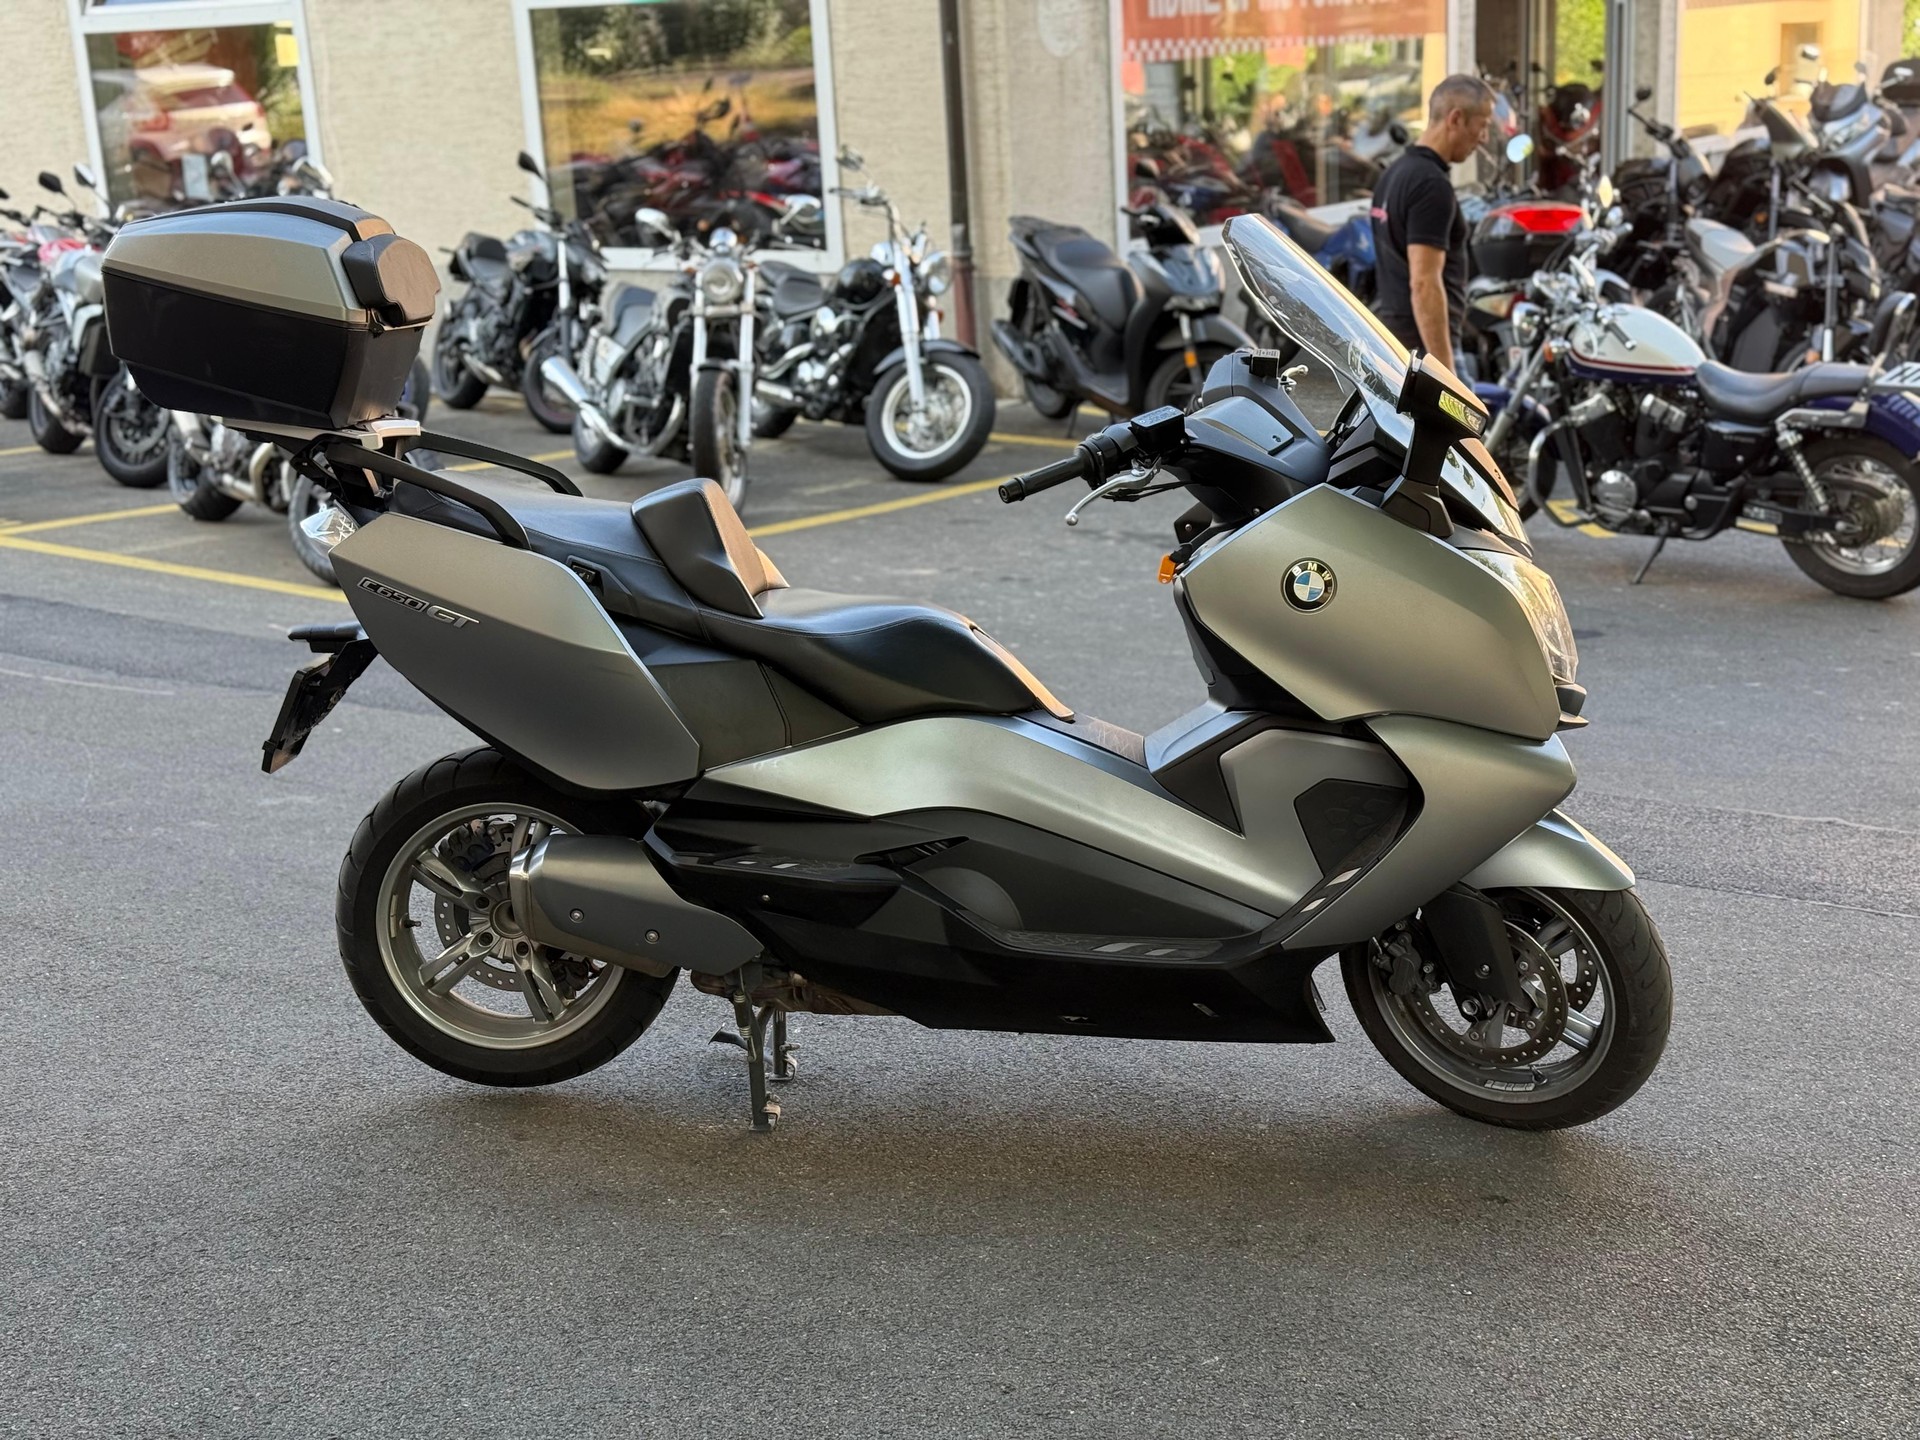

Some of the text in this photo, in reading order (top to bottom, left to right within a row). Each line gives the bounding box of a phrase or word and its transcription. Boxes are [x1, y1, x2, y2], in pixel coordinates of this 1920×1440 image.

[1292, 561, 1332, 581] BMW
[361, 579, 480, 628] C650 GT
